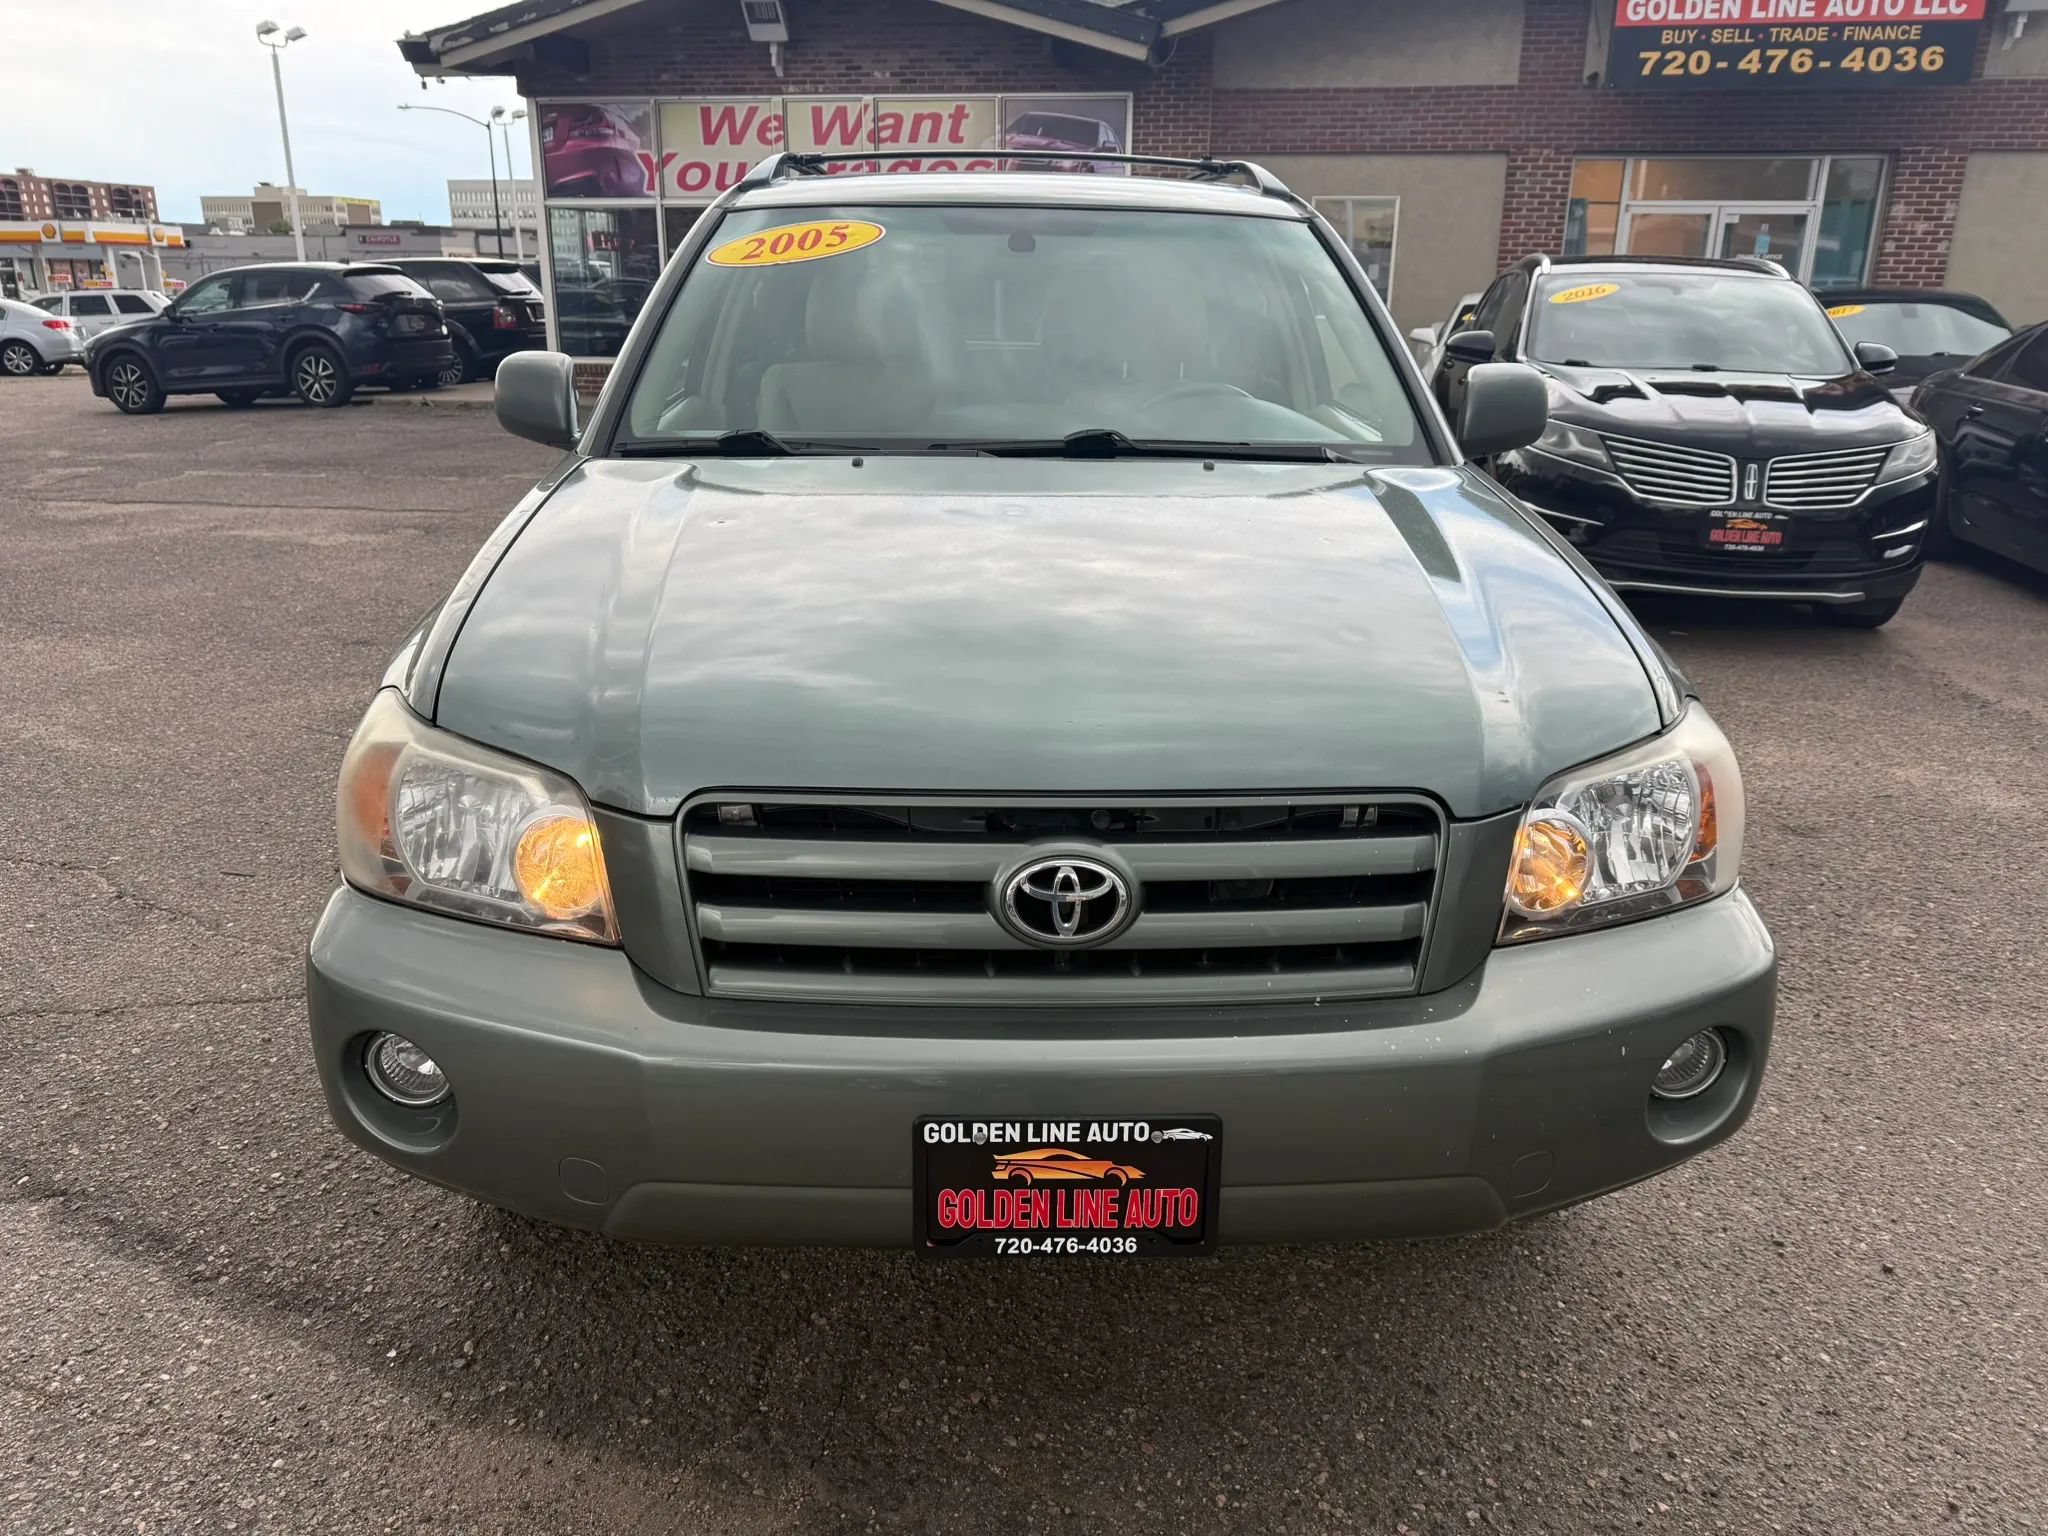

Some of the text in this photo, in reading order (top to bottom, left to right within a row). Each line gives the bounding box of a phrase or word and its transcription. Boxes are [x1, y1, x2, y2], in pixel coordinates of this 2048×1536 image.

[1626, 0, 1969, 21] GOLDEN LINE AUTO LLC
[1661, 25, 1922, 44] BUY SELL TRADE FINANCE
[700, 103, 970, 146] We Want
[636, 152, 752, 192] You
[740, 223, 850, 261] 2005
[1562, 286, 1607, 301] 2016
[1027, 1122, 1081, 1143] LINE
[1086, 1121, 1150, 1143] AUTO
[937, 1187, 1199, 1229] GOLDEN LINE AUTO
[994, 1237, 1138, 1254] 720-476-4036
